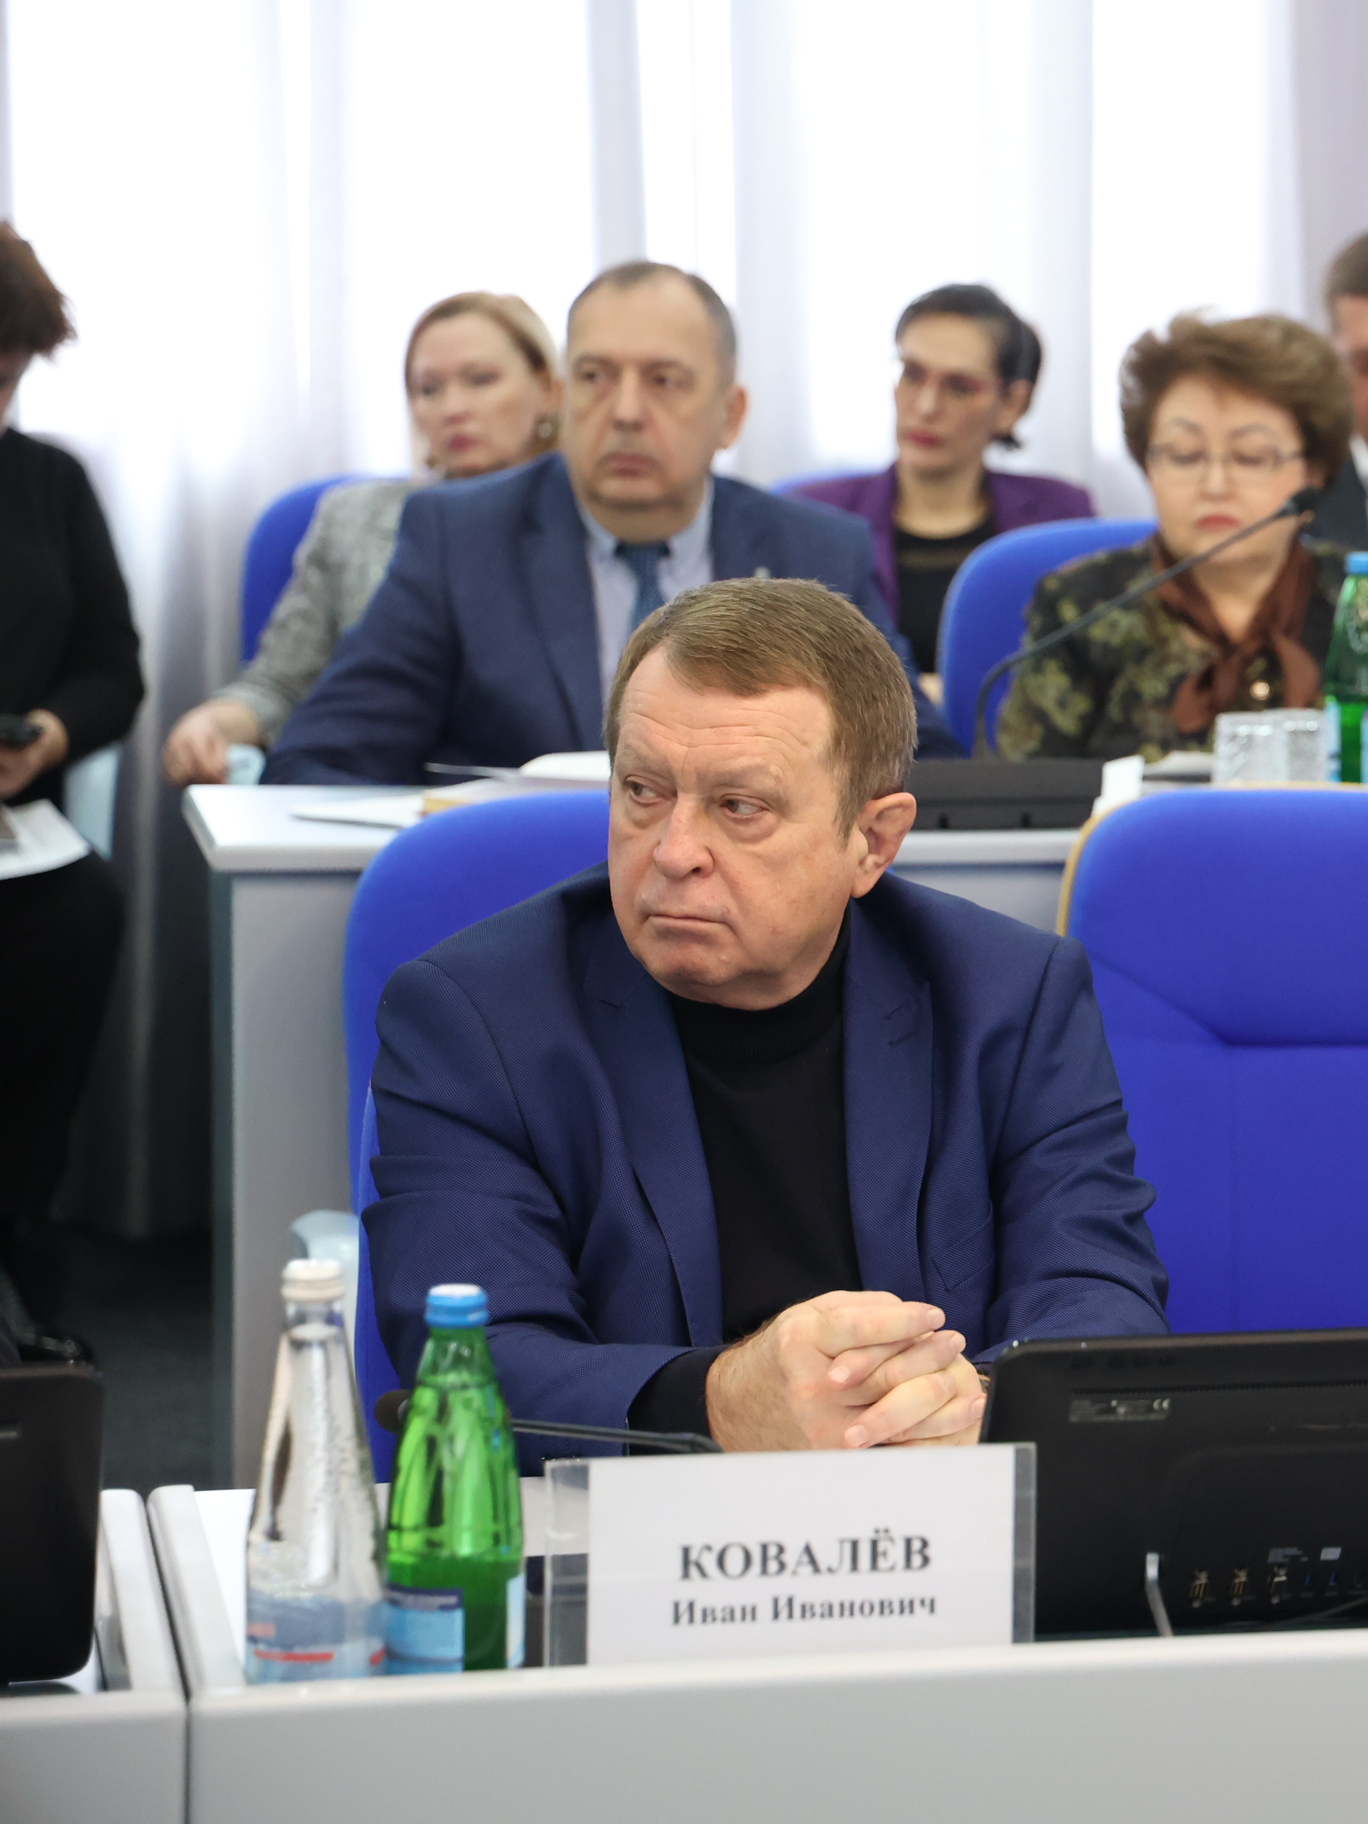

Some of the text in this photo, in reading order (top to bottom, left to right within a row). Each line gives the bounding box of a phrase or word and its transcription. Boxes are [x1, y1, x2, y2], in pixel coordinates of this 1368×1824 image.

[679, 1527, 932, 1580] КОВАЛЁВ
[672, 1595, 937, 1626] Иван Иванович
